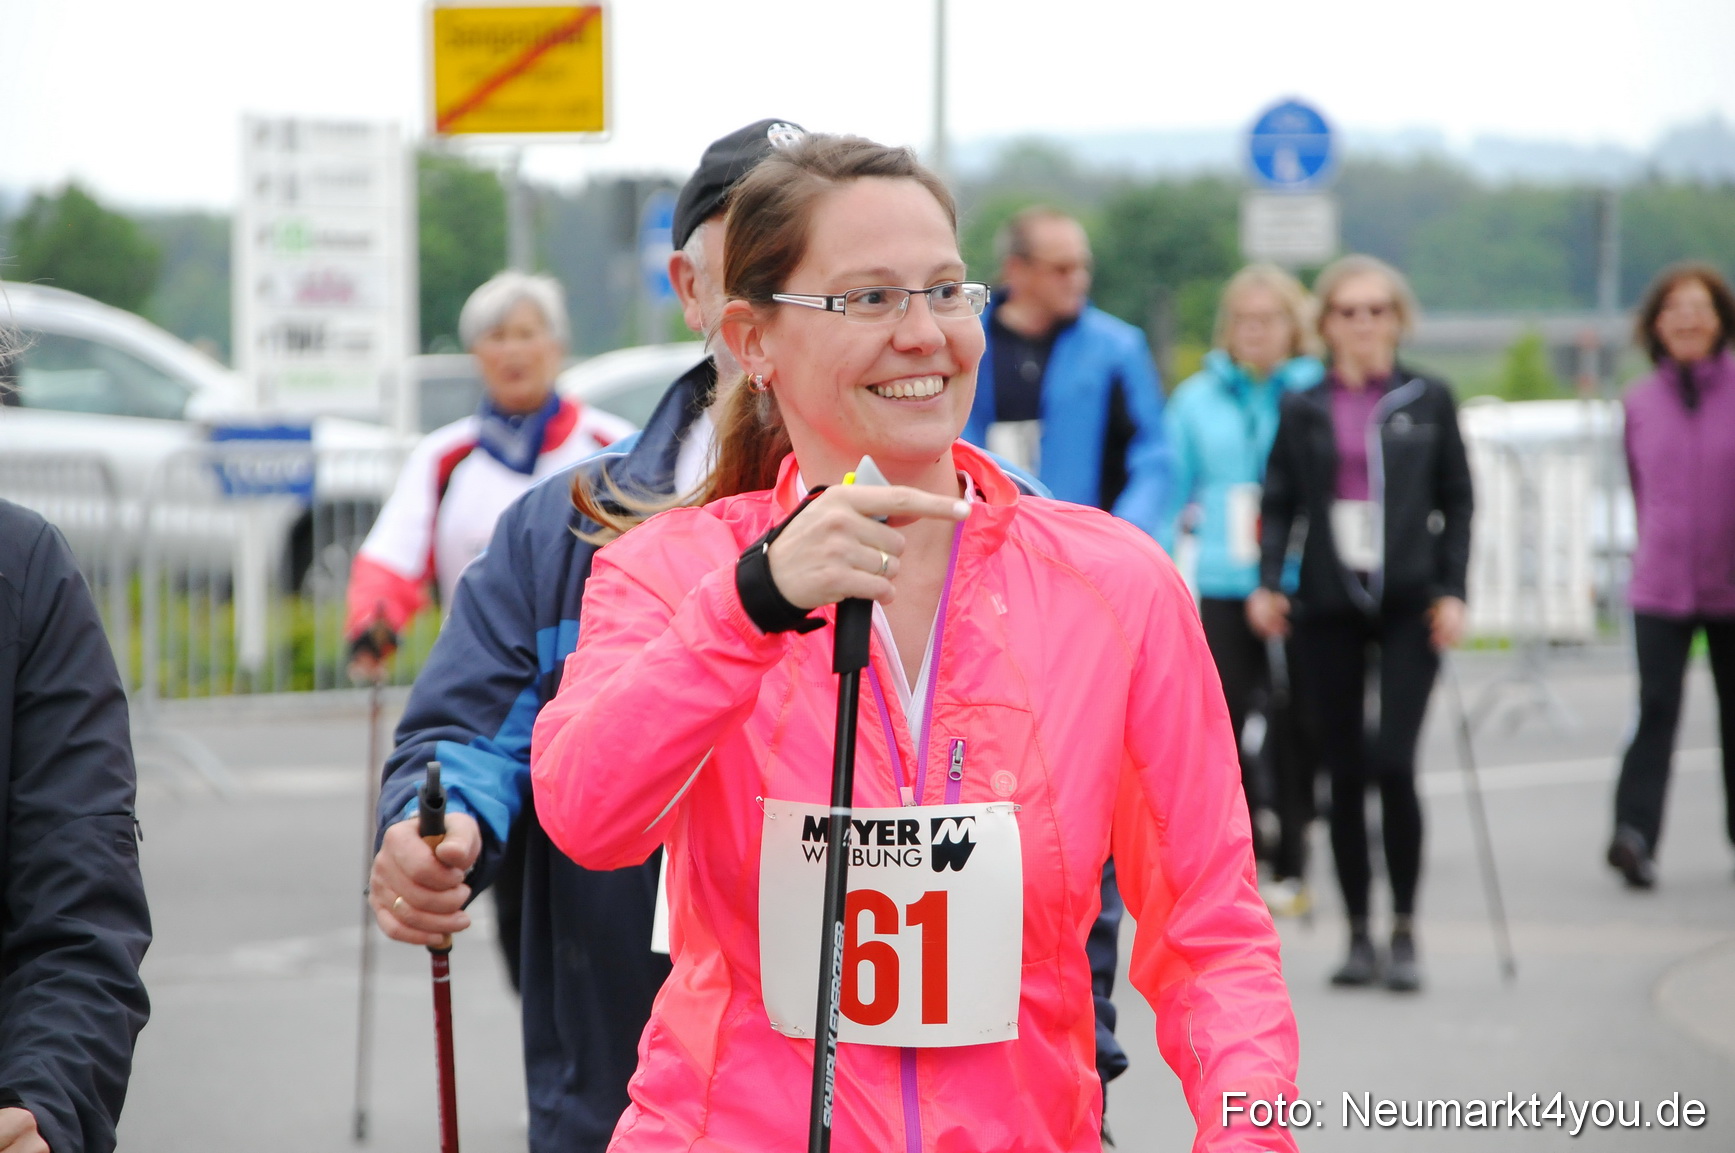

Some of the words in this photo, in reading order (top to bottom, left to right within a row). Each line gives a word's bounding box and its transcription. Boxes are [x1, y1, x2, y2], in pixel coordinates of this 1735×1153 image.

[801, 815, 922, 846] MYER
[802, 844, 922, 868] WBUNG
[839, 889, 948, 1026] 61
